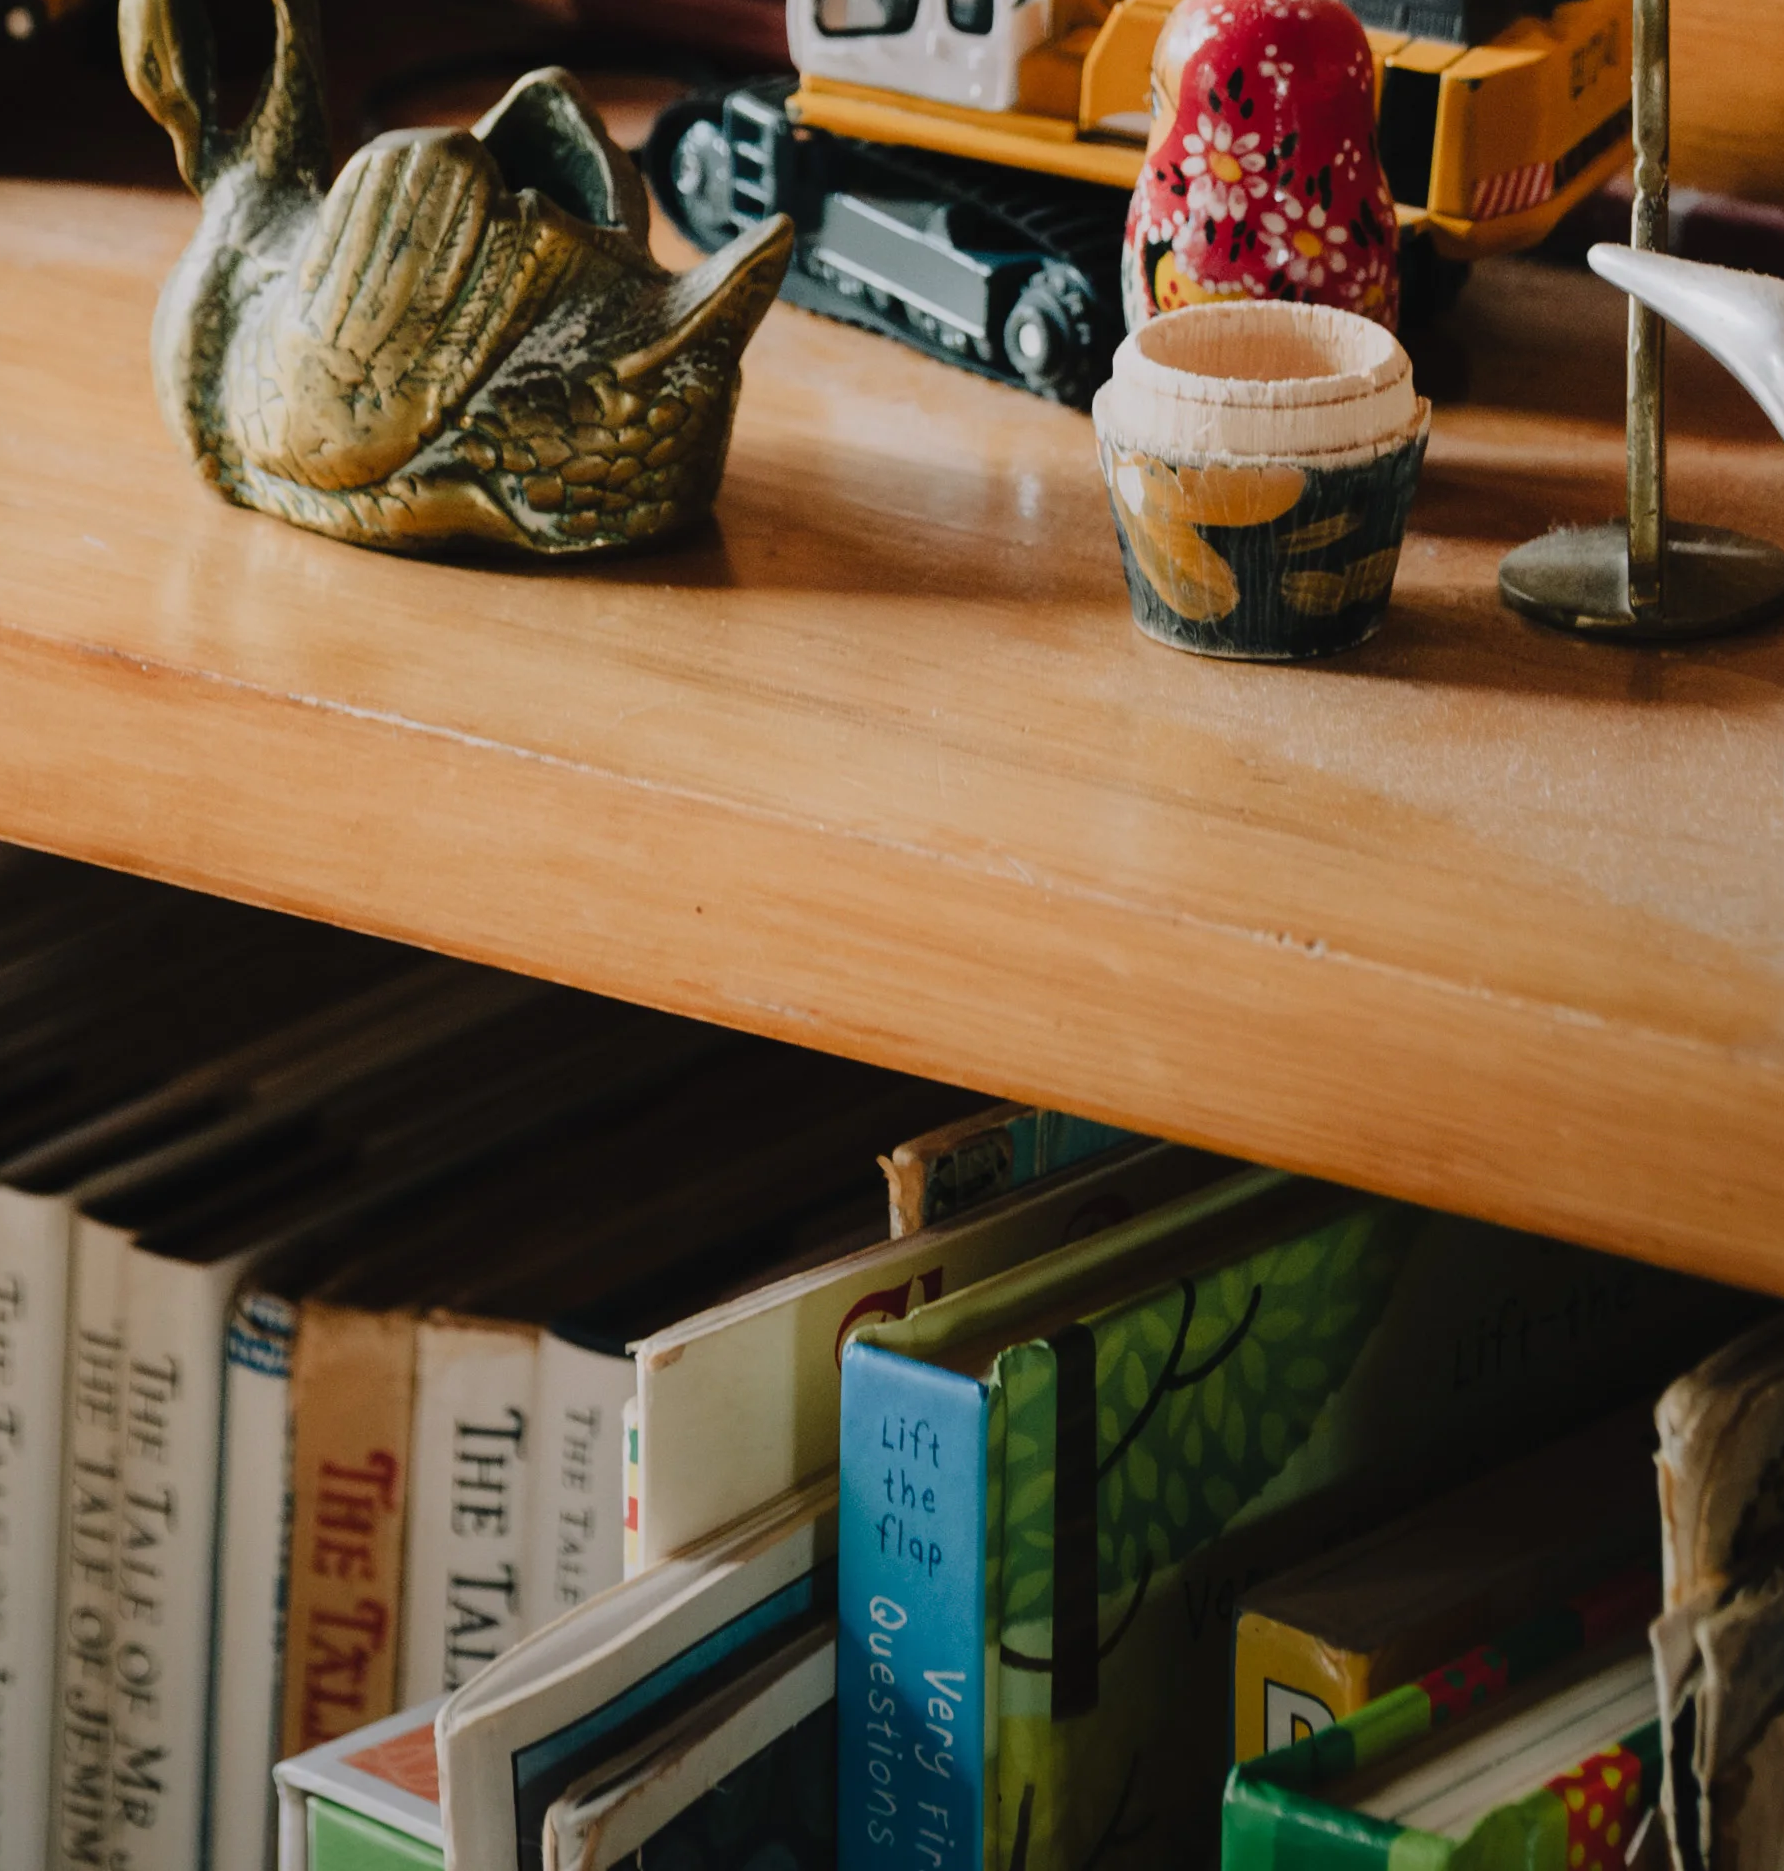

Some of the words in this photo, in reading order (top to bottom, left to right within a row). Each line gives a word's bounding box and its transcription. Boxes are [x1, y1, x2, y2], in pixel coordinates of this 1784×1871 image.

[74, 1318, 129, 1433] THE
[127, 1352, 186, 1467] THE
[451, 1404, 528, 1539] THE
[561, 1405, 602, 1493] THE
[880, 1416, 942, 1470] Lift
[884, 1467, 937, 1515] the
[68, 1446, 125, 1594] TALE
[118, 1480, 183, 1628] TALE
[312, 1448, 400, 1581] THE
[554, 1507, 597, 1608] TALE
[875, 1512, 944, 1577] flap
[67, 1604, 119, 1680] OF
[114, 1640, 167, 1722] OF
[442, 1559, 521, 1693] TAL
[867, 1593, 910, 1847] Questions
[914, 1668, 967, 1781] Very
[108, 1728, 175, 1831] MR
